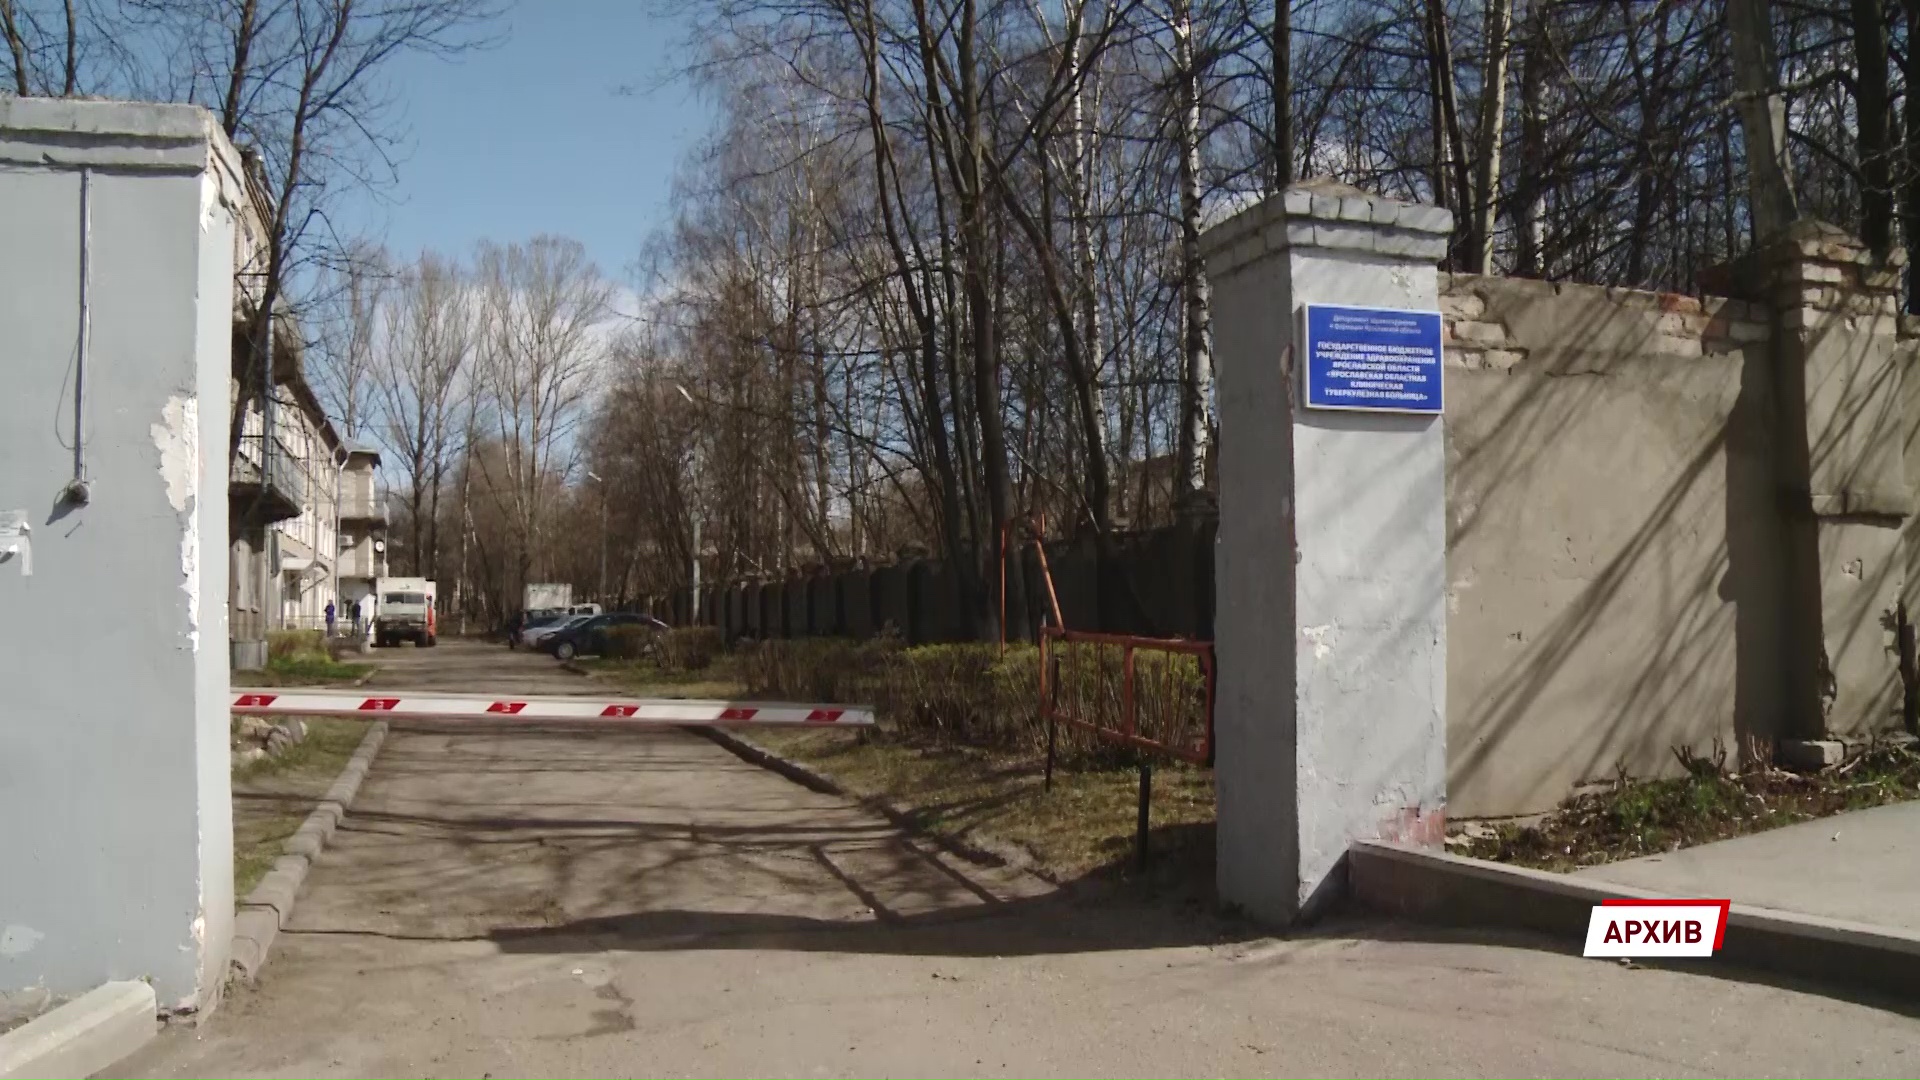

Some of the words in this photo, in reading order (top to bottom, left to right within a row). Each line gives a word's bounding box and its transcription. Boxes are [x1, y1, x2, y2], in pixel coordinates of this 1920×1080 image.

[1317, 341, 1387, 352] ГОСУДАРСТВЕННОЕ
[1388, 345, 1433, 355] БЮДЖЕТНОЕ
[1316, 352, 1365, 360] УЧРЕЖДЕНИЕ
[1366, 353, 1436, 364] ЗДРАВООХРАНЕНИЯ
[1333, 362, 1386, 371] ЯРОСЛАВСКОЙ
[1326, 371, 1384, 380] «ЯРОСЛАВСКАЯ
[1384, 374, 1427, 382] ОБЛАСТНАЯ
[1350, 381, 1404, 390] КЛИНИЧЕСКАЯ
[1325, 389, 1384, 398] ТУБЕРКУЛЕЗНАЯ
[1385, 391, 1428, 401] БОЛЬНИЦА»
